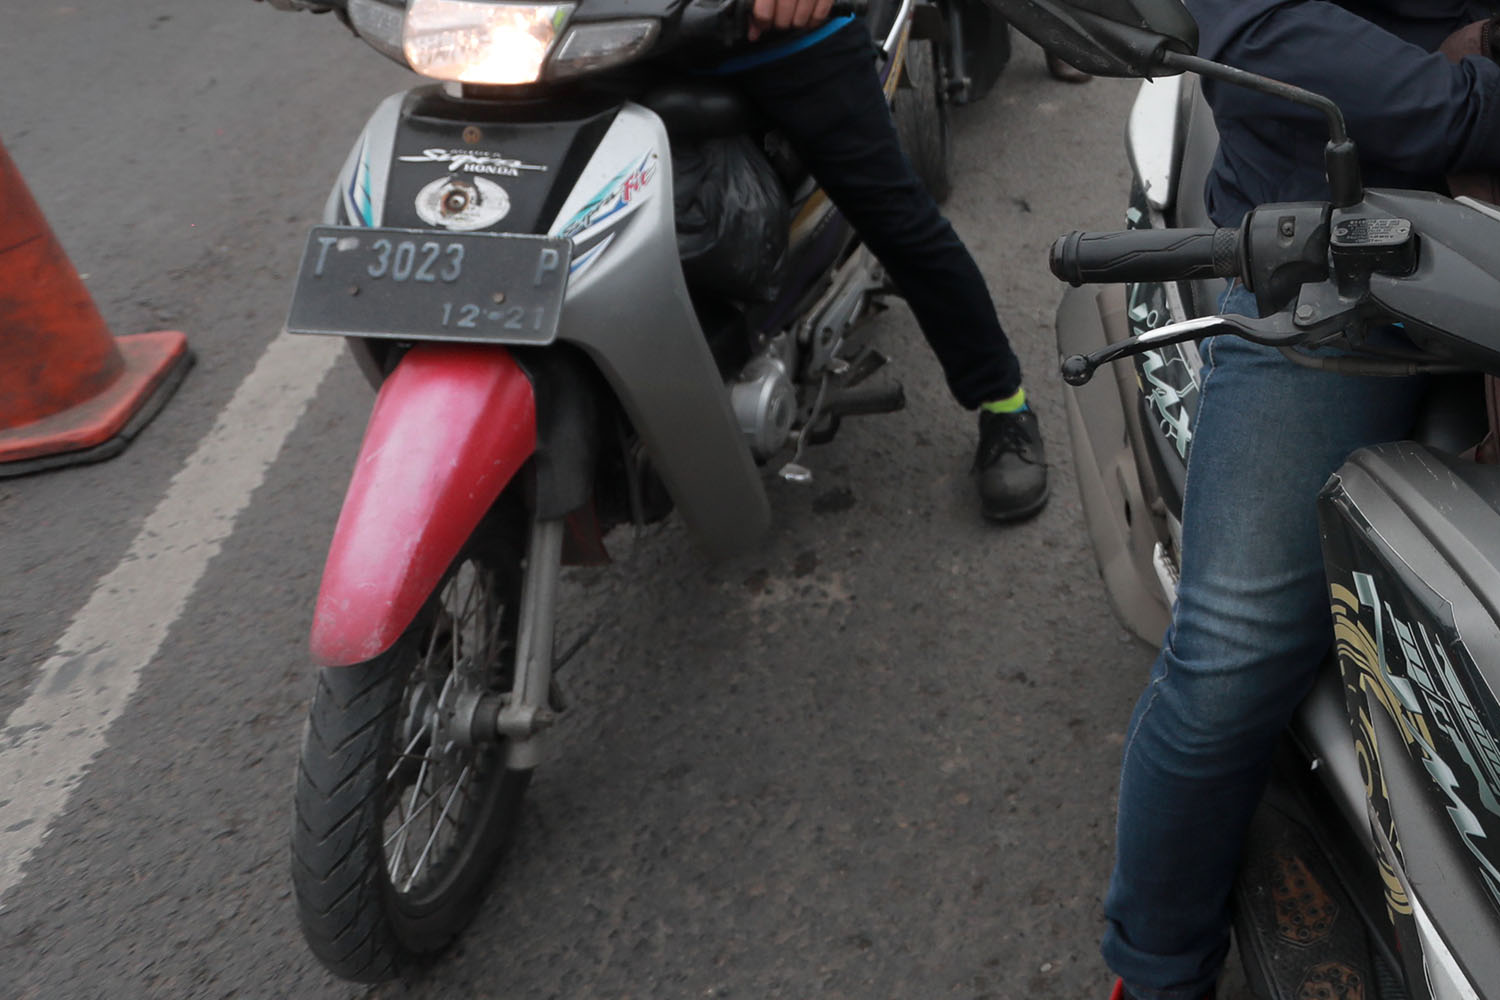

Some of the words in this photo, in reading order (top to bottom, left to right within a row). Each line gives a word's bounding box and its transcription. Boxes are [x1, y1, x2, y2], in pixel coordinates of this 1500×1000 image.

[464, 163, 519, 176] HONDA
[312, 237, 337, 277] T
[367, 238, 465, 284] 3023
[533, 248, 559, 287] P
